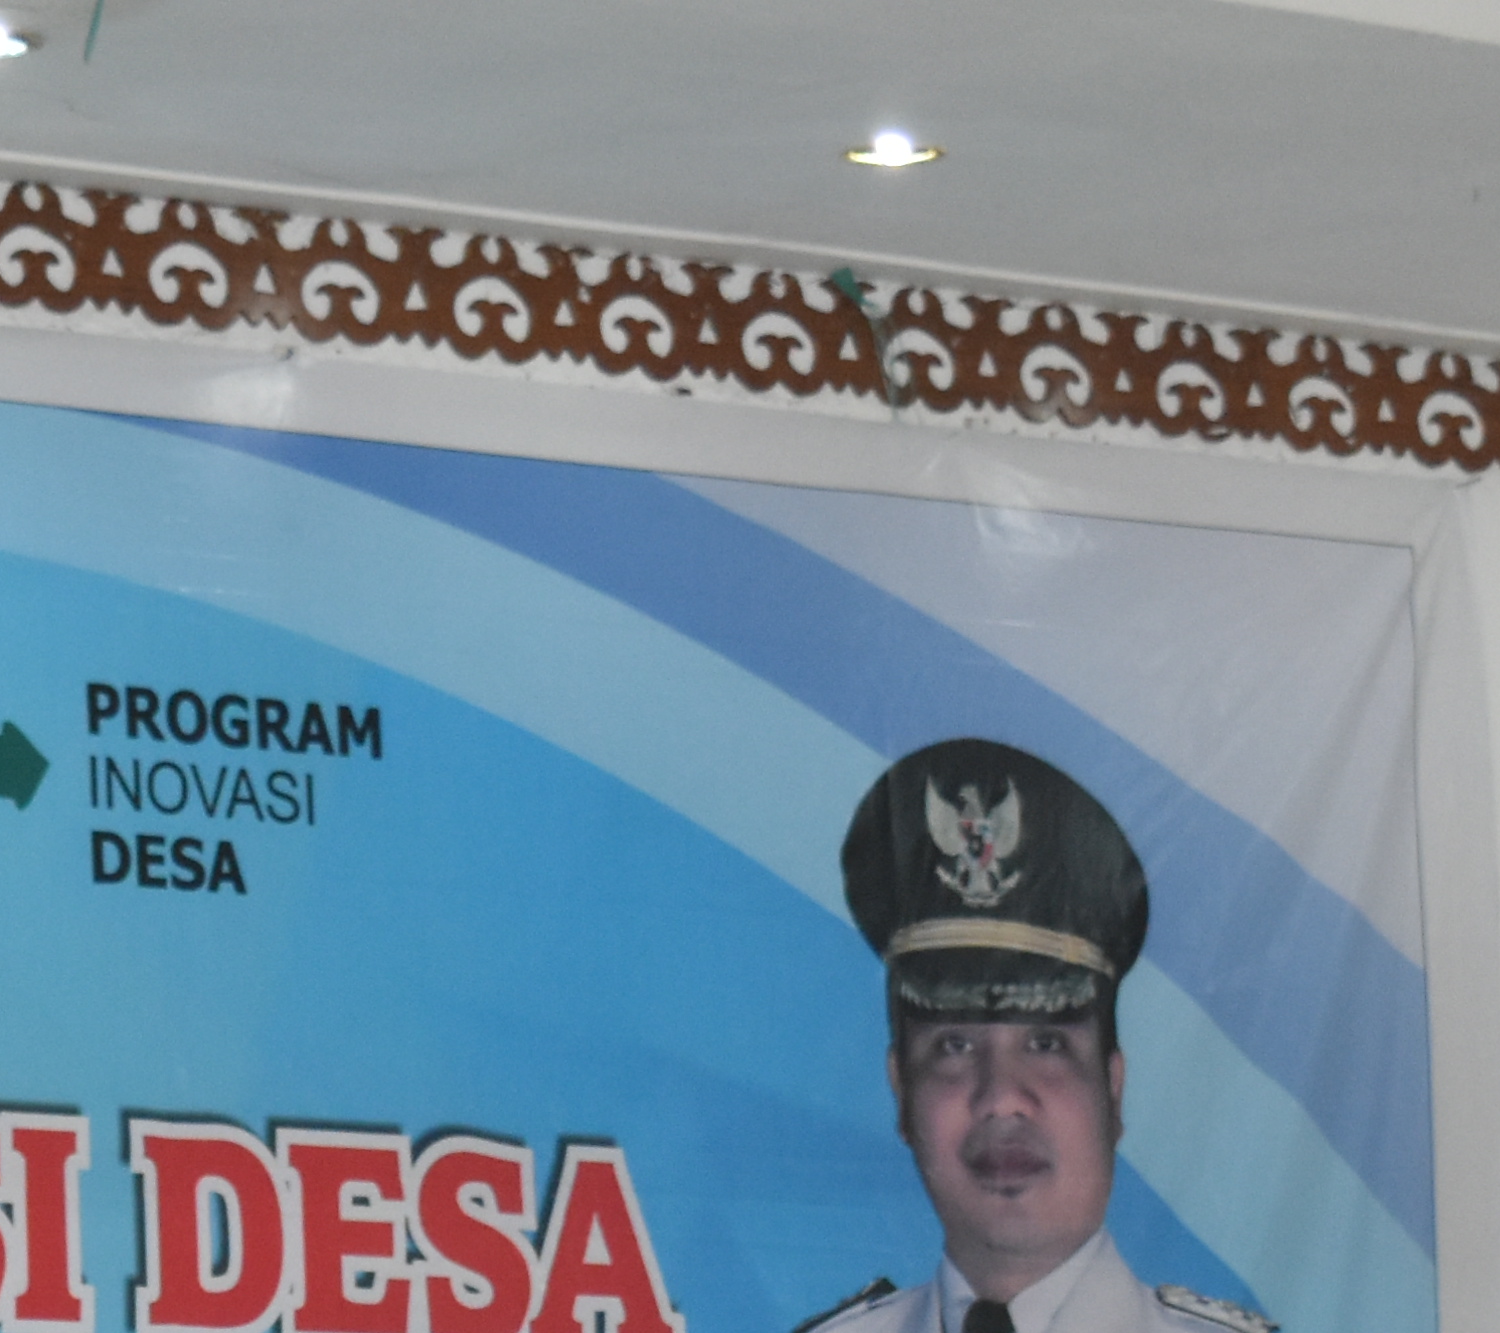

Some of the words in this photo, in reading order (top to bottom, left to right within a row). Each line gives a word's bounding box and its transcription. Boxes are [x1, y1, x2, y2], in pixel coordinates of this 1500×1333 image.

[85, 682, 383, 760] PROGRAM
[88, 755, 317, 827] INOVASI
[90, 830, 248, 895] DESA
